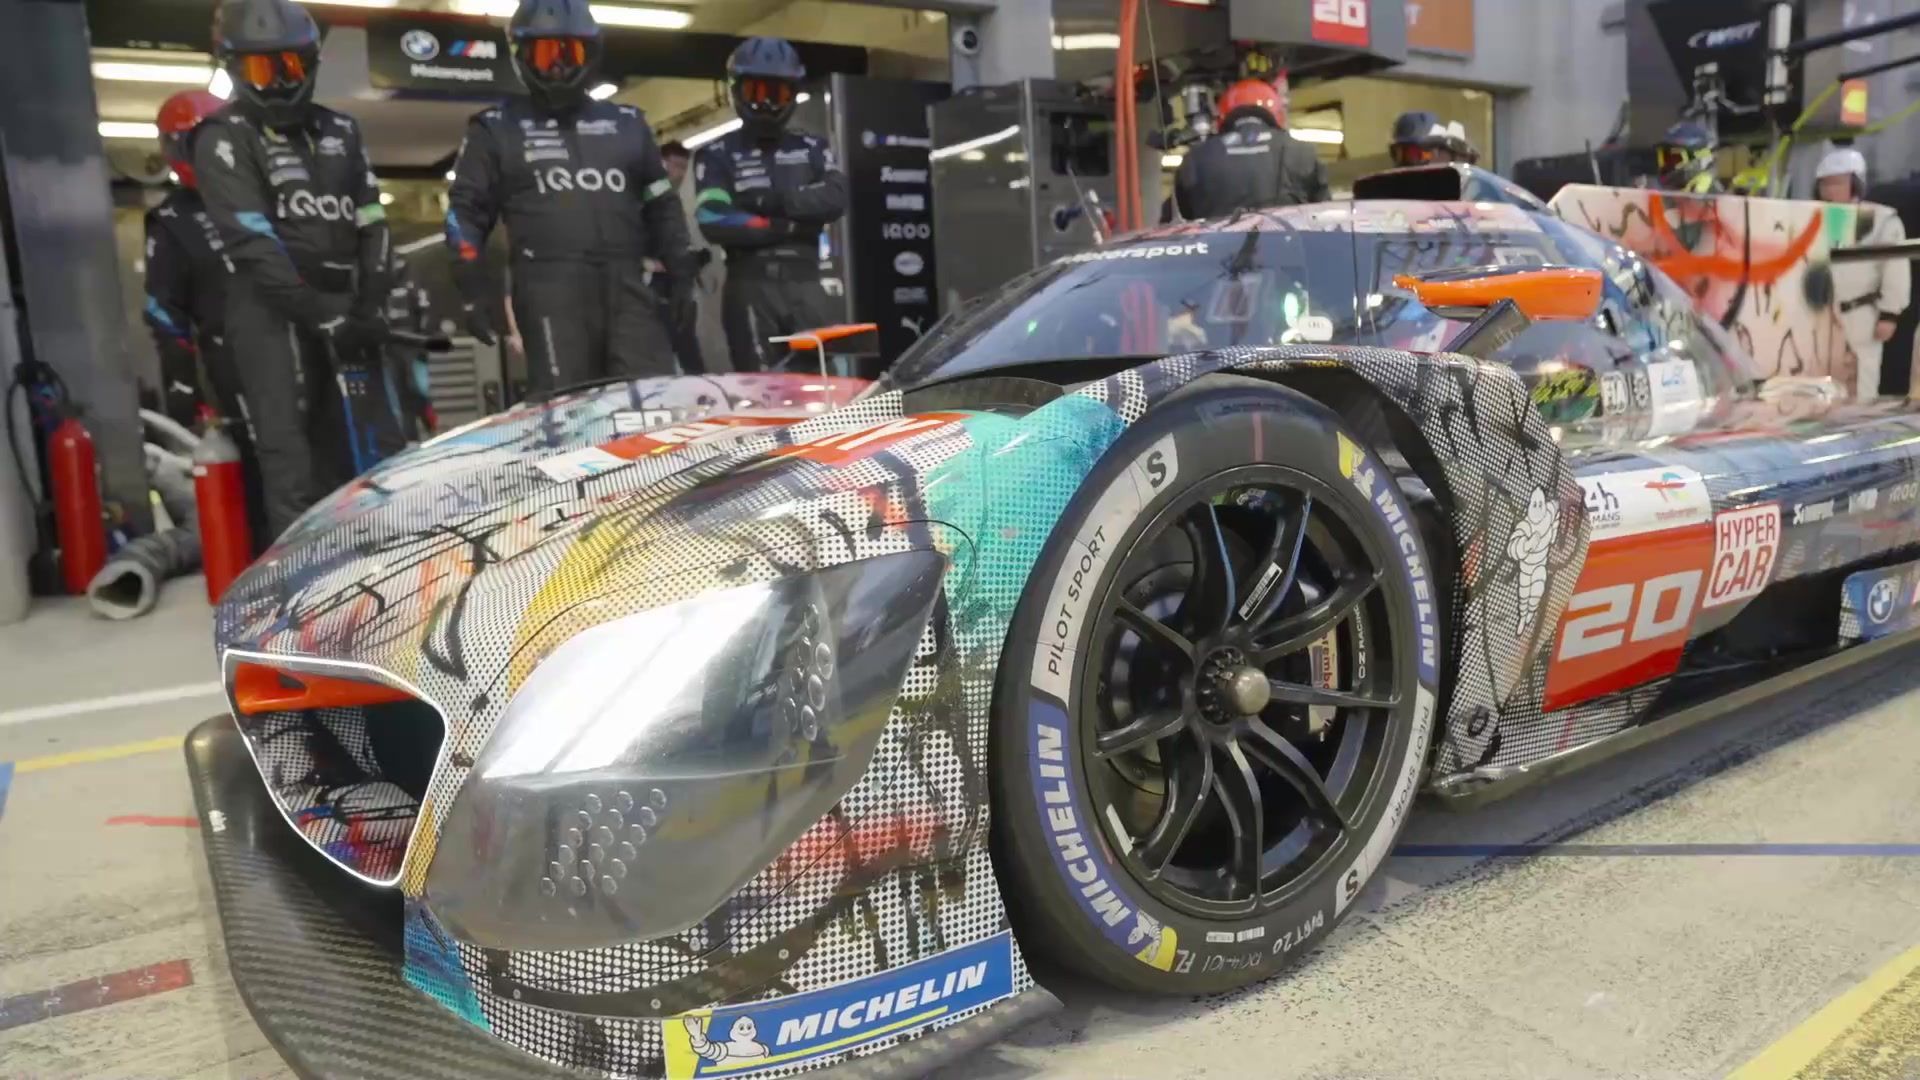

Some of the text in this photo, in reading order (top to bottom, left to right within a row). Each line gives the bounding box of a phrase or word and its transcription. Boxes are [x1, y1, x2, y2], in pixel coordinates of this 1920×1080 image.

[1313, 0, 1367, 28] 20
[277, 188, 355, 221] iQOO
[532, 166, 627, 194] iQOO
[1146, 450, 1167, 489] S
[1720, 512, 1776, 551] HYPER
[1376, 489, 1436, 669] MICHELIN
[1710, 544, 1773, 599] CAR
[1048, 525, 1107, 676] PILOT SPORT
[1557, 569, 1704, 662] 20
[1414, 706, 1430, 762] PILOT
[1037, 723, 1132, 928] MICHELIN
[775, 961, 988, 1047] MICHELIN
